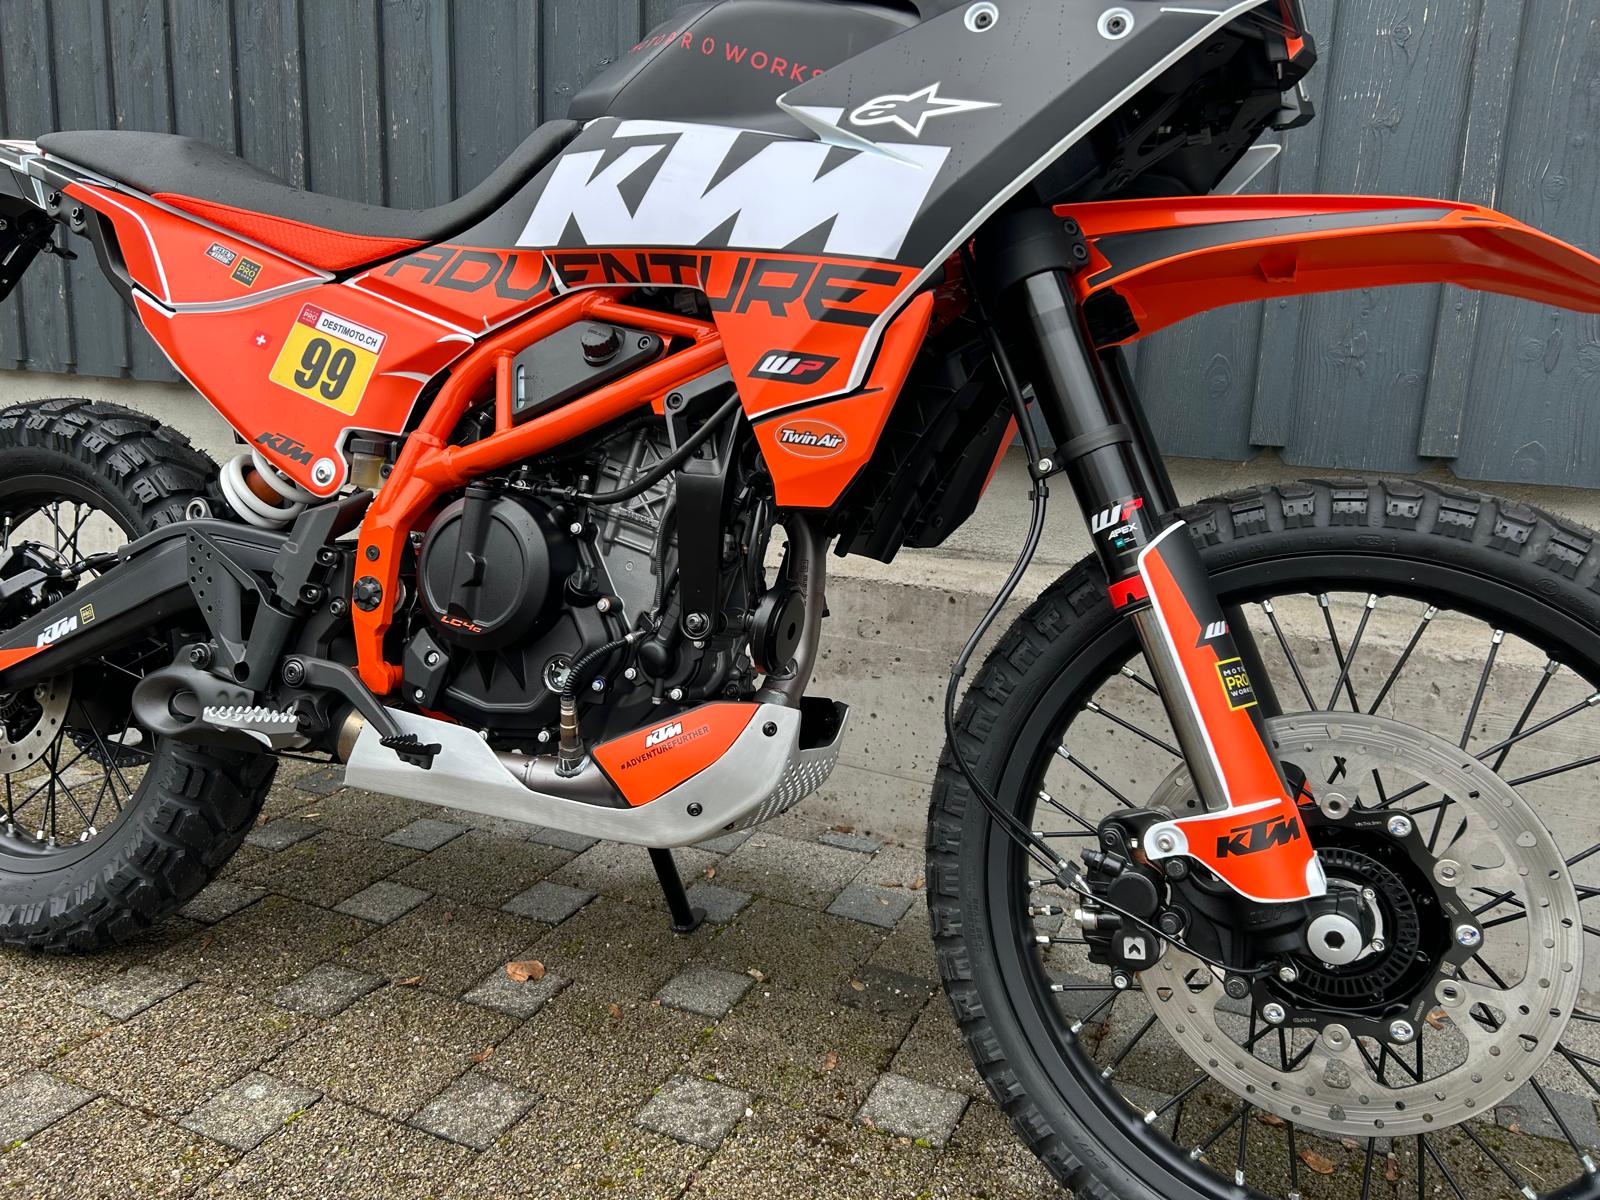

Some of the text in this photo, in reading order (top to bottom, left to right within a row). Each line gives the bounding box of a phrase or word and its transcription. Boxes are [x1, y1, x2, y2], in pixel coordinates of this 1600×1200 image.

[515, 120, 951, 260] KTM
[238, 264, 256, 278] PRO
[384, 245, 903, 328] ADVENTURE
[303, 311, 318, 321] PRO
[321, 318, 378, 347] DESTIMOTO.CH
[294, 337, 357, 401] 99
[758, 355, 825, 376] WP
[254, 431, 314, 466] KTM
[781, 429, 843, 448] Twin Air
[1091, 497, 1143, 534] WP
[1108, 522, 1138, 540] APEX
[36, 615, 78, 649] KTM
[1204, 620, 1230, 640] W
[1225, 673, 1250, 690] PRO
[620, 726, 710, 771] #ADVENTUREFURTHER
[644, 721, 683, 750] KTM
[1216, 815, 1300, 859] KTM
